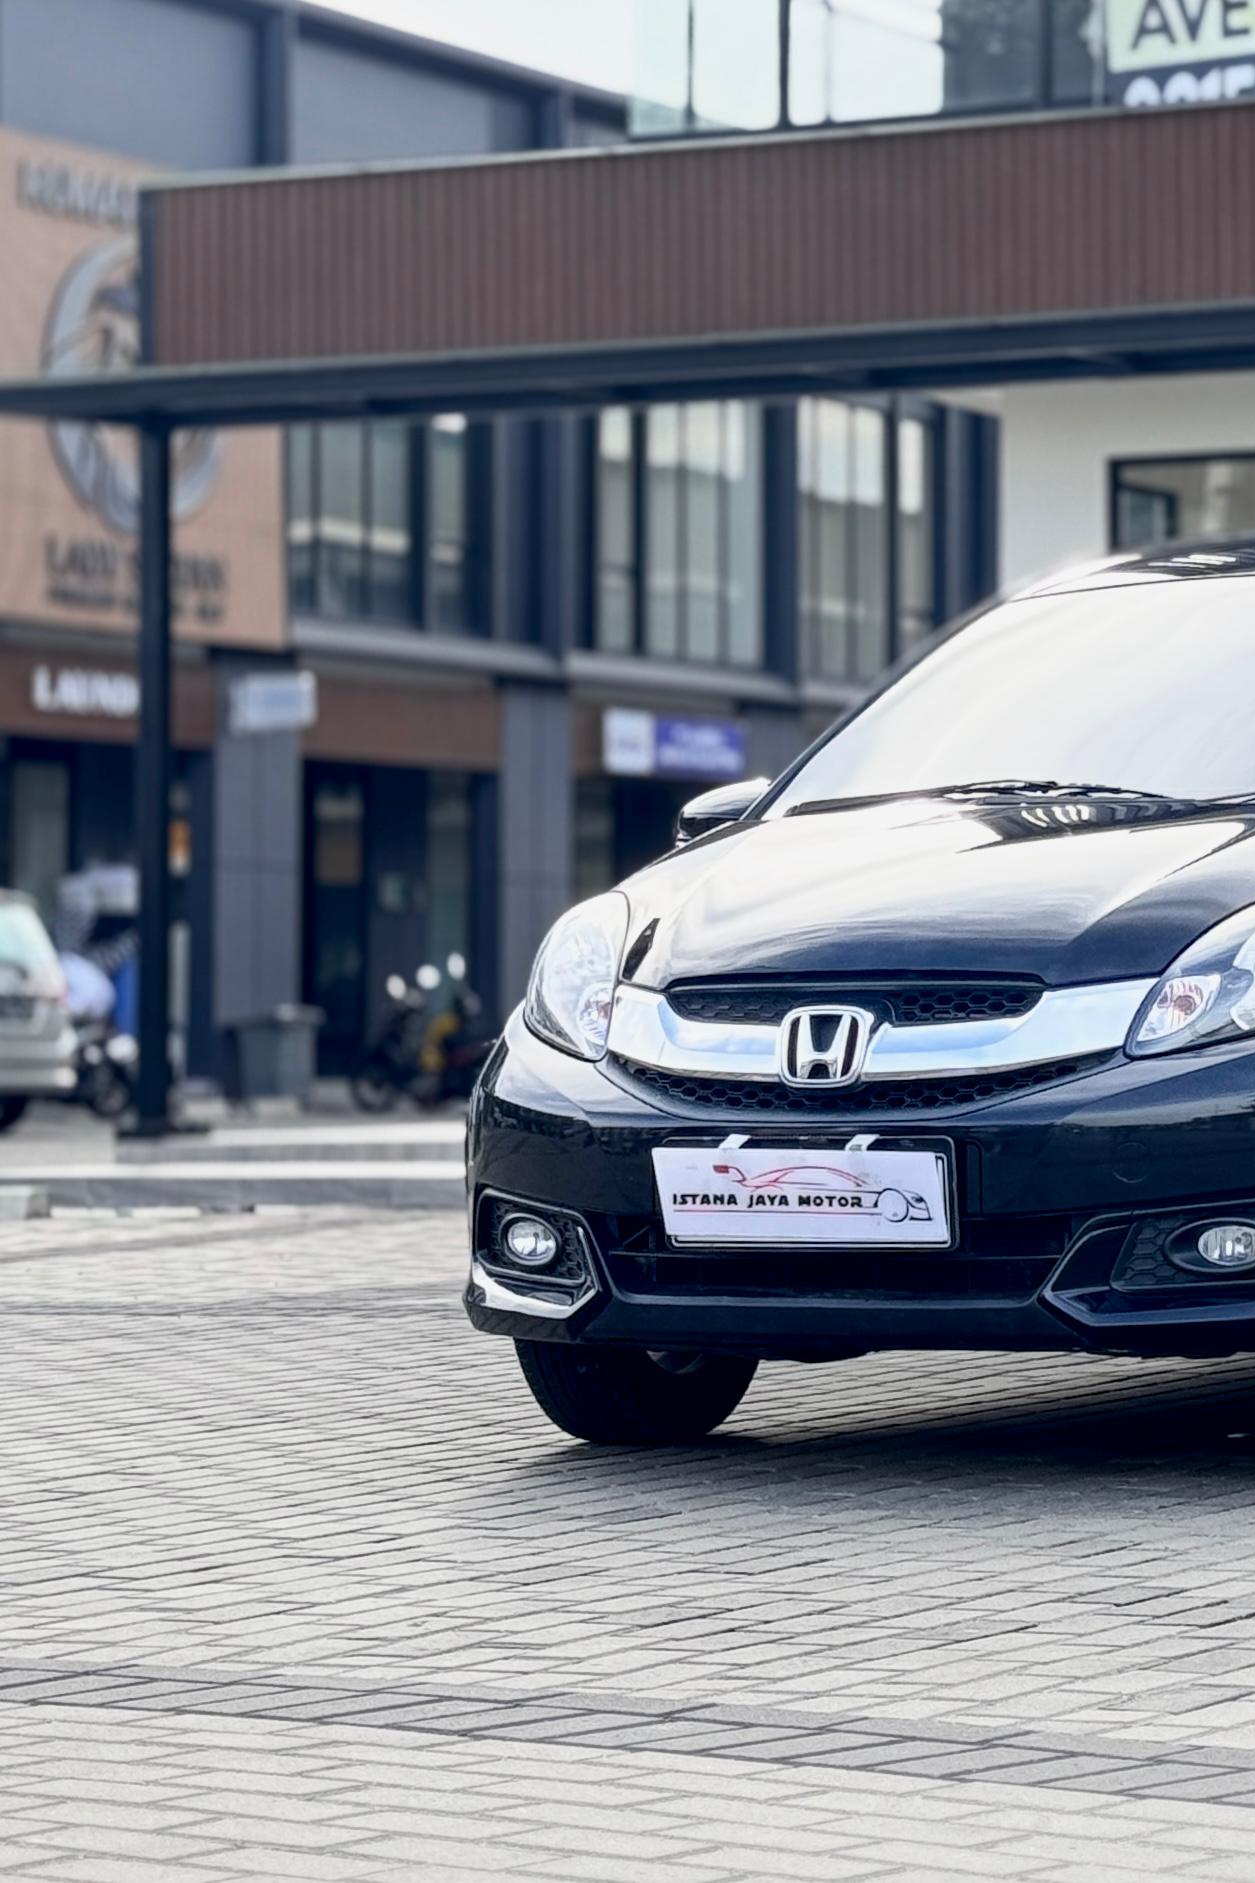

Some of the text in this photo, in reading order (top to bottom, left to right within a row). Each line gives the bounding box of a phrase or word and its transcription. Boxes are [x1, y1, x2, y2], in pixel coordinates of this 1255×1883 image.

[672, 1193, 863, 1208] ISTANA JAYA MOTOR
